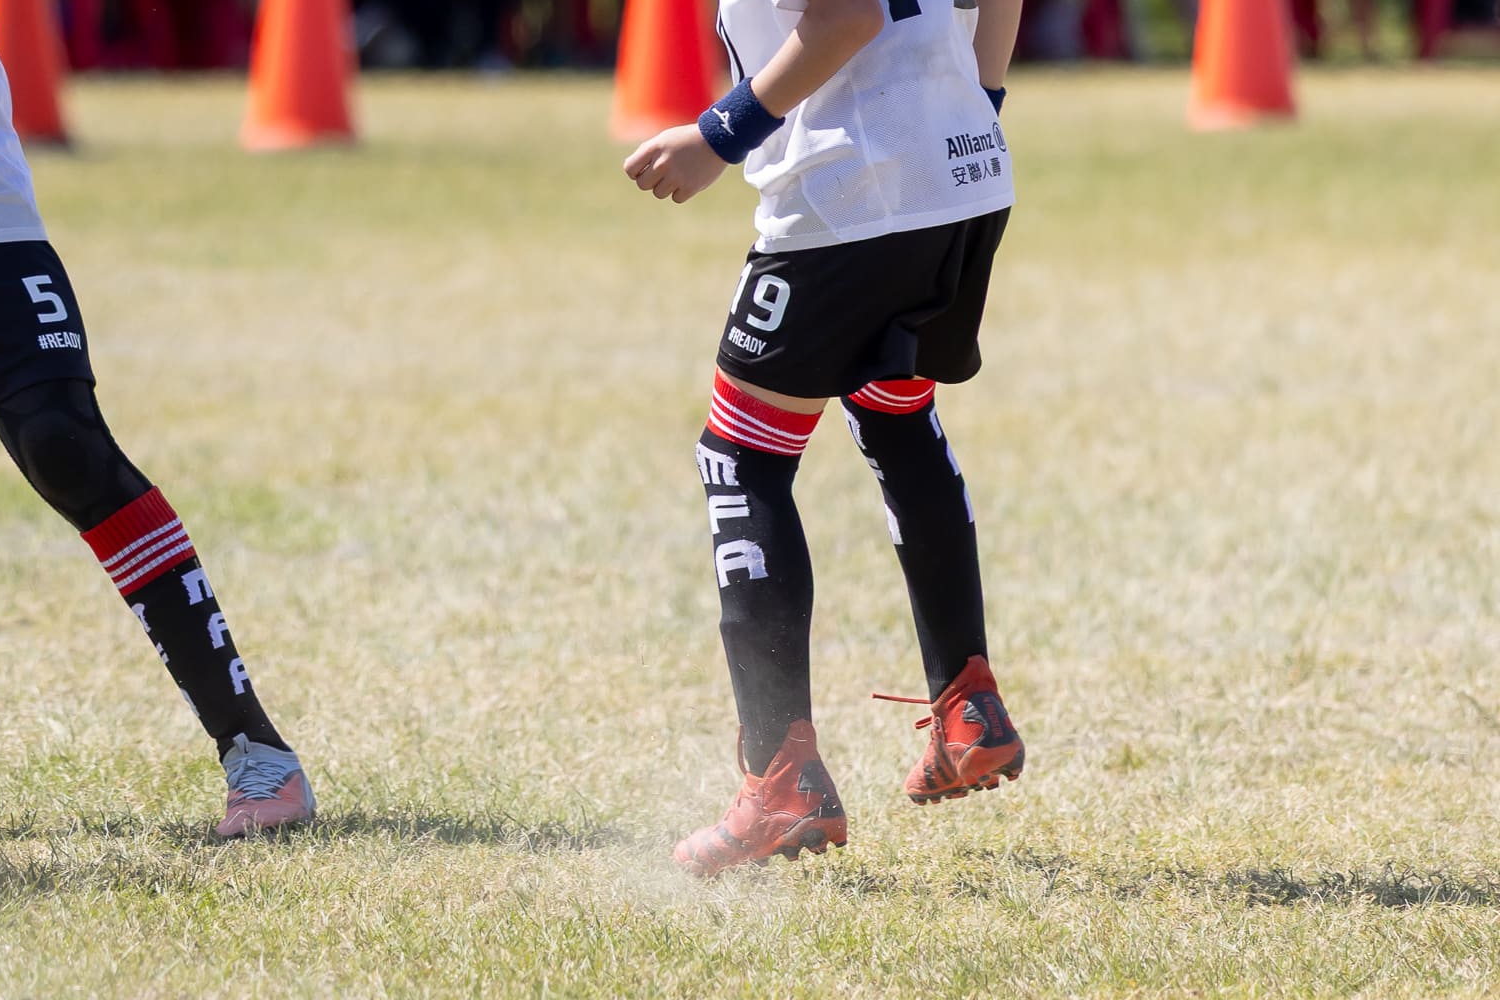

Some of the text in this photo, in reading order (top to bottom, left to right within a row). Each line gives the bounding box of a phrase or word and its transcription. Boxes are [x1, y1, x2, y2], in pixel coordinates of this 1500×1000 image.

[946, 133, 995, 160] Allianz
[951, 157, 1002, 187] 安聯人壽
[21, 274, 68, 323] 5
[731, 262, 791, 332] 19
[37, 332, 82, 350] #READY
[728, 326, 768, 356] #READY
